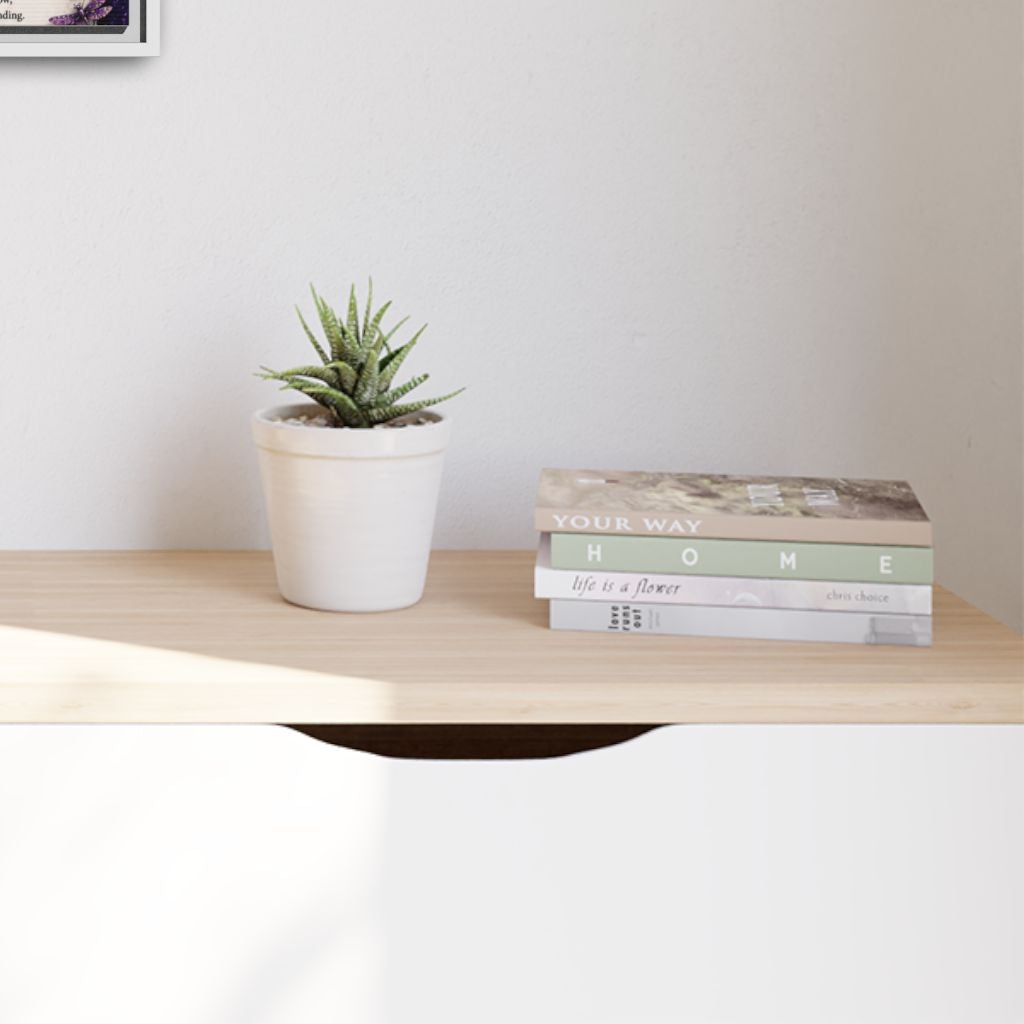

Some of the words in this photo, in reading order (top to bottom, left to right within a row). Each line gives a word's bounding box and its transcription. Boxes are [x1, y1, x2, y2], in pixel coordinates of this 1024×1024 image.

[552, 514, 633, 531] YOUR
[642, 517, 703, 533] WAY
[572, 575, 596, 597] life
[602, 578, 615, 592] is
[620, 582, 628, 593] a
[631, 577, 682, 599] flower
[826, 589, 852, 602] chris
[855, 590, 890, 603] choice
[608, 605, 619, 630] love
[622, 605, 630, 631] runs
[632, 608, 642, 628] out
